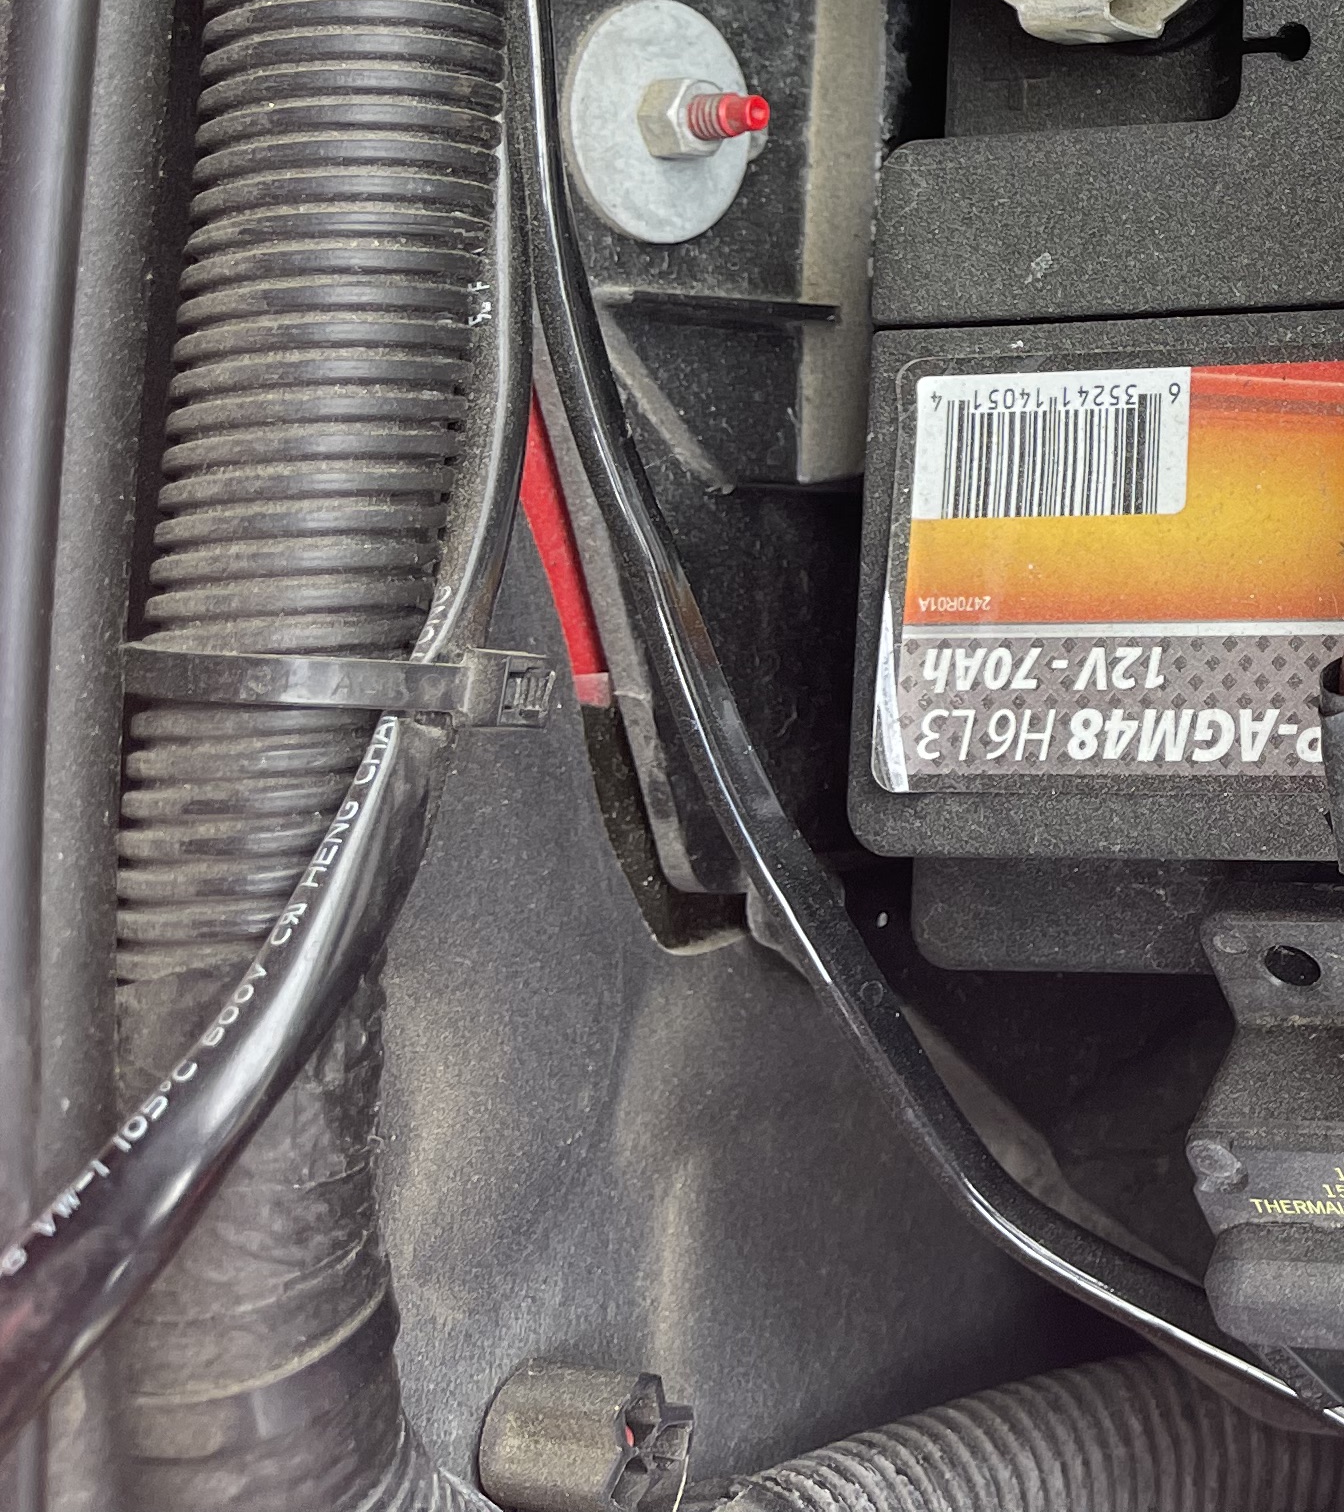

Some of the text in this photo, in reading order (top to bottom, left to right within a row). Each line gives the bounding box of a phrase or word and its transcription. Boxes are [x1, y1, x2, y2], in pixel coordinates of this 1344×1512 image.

[971, 386, 1044, 411] 14051
[1061, 383, 1139, 408] 35241
[917, 594, 992, 613] 2470R01A
[922, 646, 1042, 694] 70Ah
[1072, 645, 1165, 691] 12V
[916, 707, 1322, 763] P-AGM48 H6 L3
[112, 1059, 198, 1153] 105°C
[202, 962, 268, 1047] 600V
[301, 800, 360, 889] HENG
